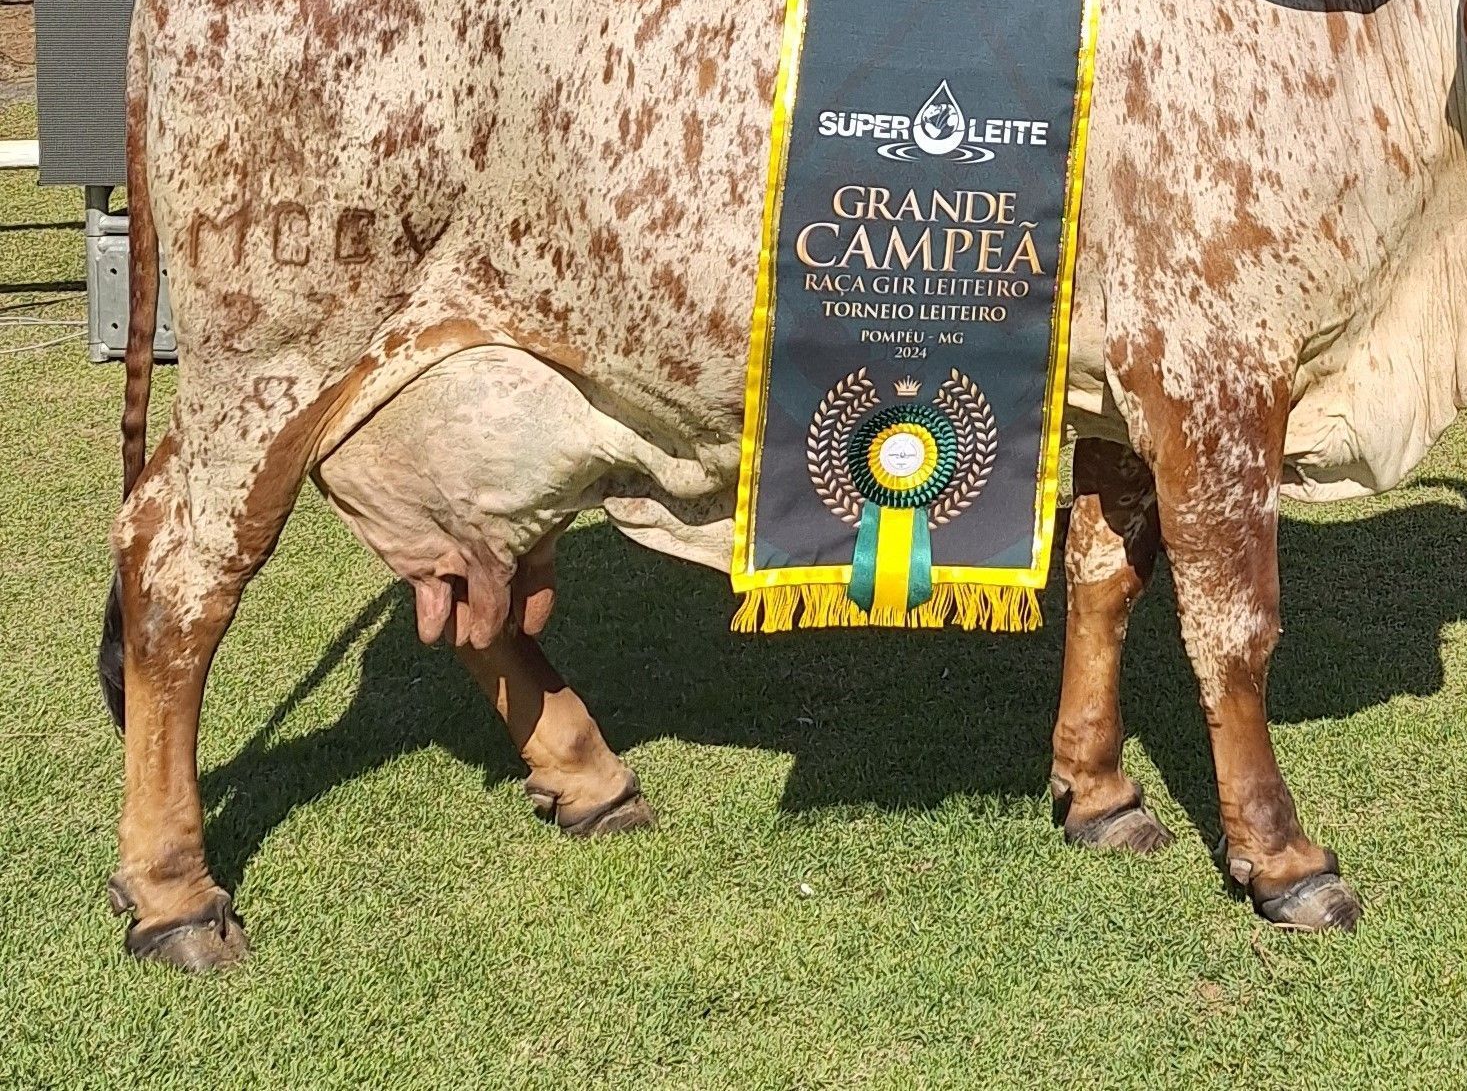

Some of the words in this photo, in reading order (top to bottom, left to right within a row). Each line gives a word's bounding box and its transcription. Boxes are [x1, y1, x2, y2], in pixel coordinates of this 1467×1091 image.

[818, 111, 911, 140] SUPER
[968, 118, 1049, 145] LEITE
[833, 185, 1017, 225] GRANDE
[796, 221, 1046, 275] CAMPEÃ
[804, 273, 866, 297] RAÇA
[872, 276, 917, 296] GIR
[924, 277, 1030, 298] LEITEIRO
[821, 301, 914, 320] TORNEIO
[919, 303, 1007, 322] LEITEIRO
[861, 328, 925, 344] POMPÉU
[938, 330, 964, 345] MG
[894, 346, 928, 359] 2024
